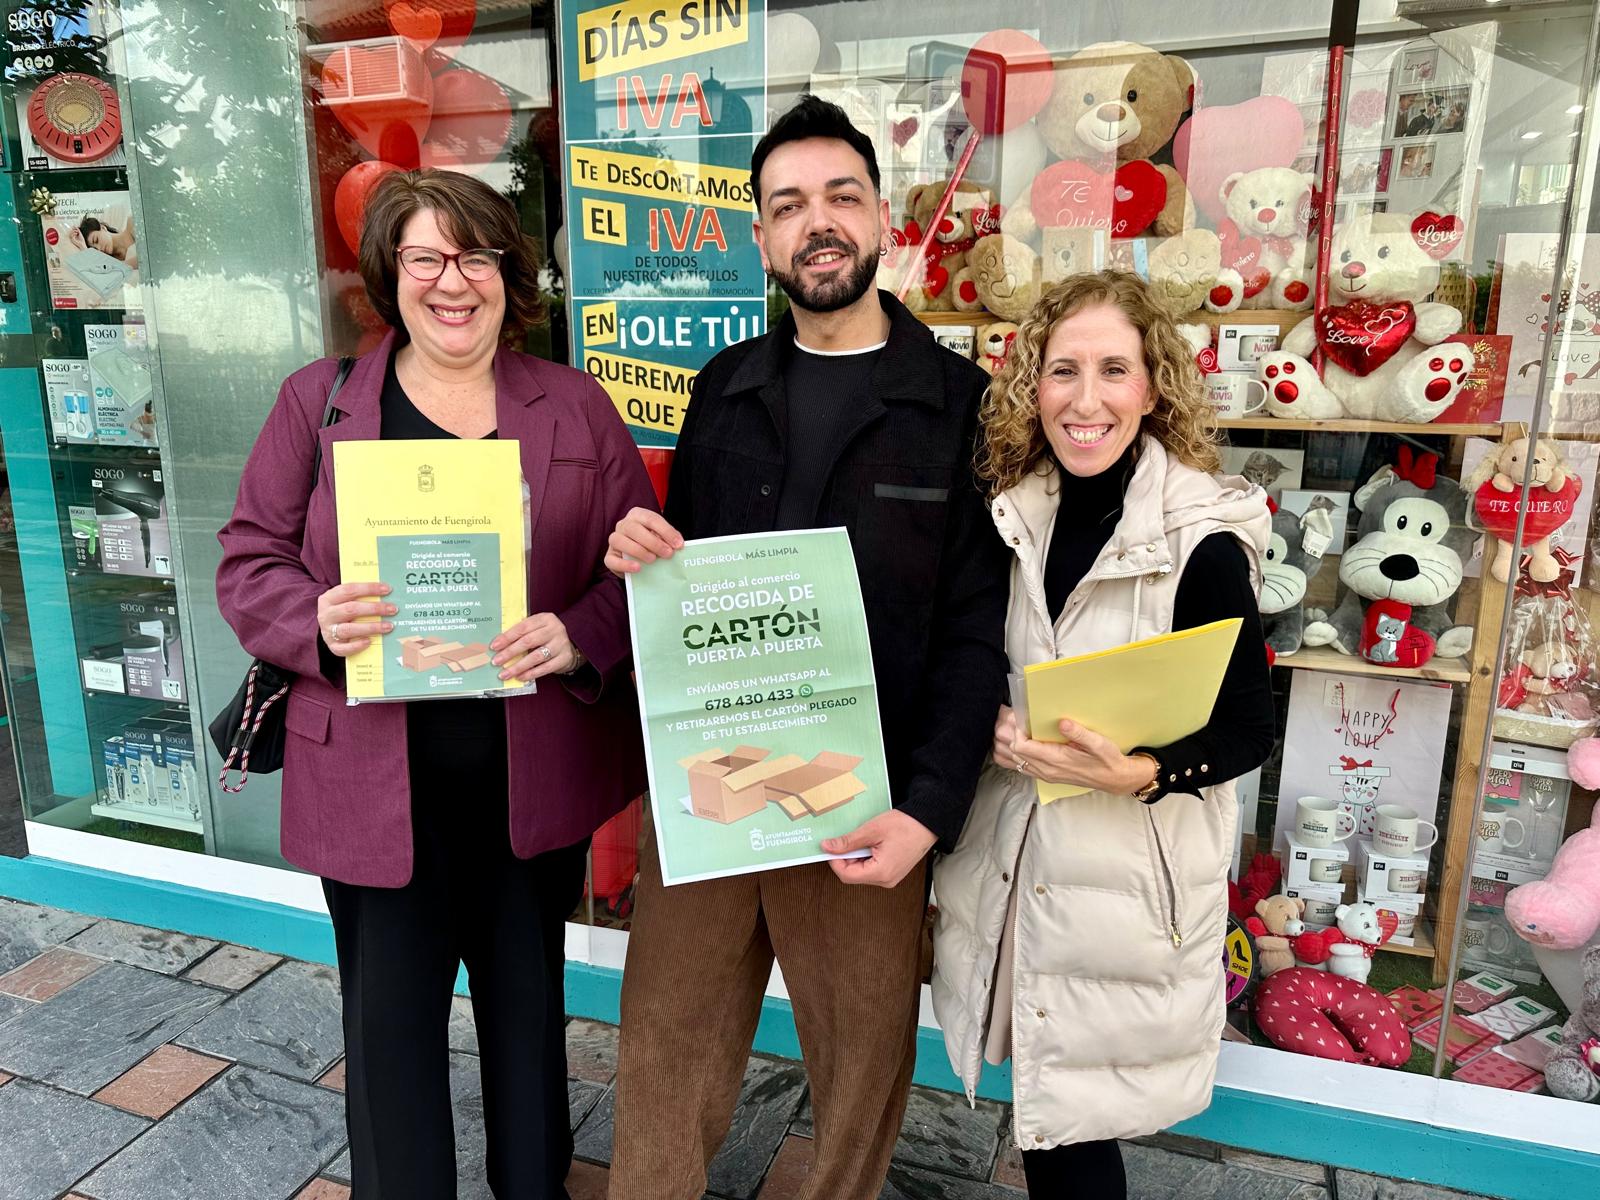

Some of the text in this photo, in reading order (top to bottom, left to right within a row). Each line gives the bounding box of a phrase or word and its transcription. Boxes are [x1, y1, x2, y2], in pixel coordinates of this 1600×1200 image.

[8, 9, 57, 32] SOGO
[584, 0, 742, 65] DÍAS SIN
[616, 72, 714, 130] IVA
[576, 158, 754, 203] TE DESCONTAMOS
[1060, 180, 1092, 203] TE
[1298, 200, 1320, 224] Love
[1056, 208, 1128, 233] Quiero
[591, 207, 728, 252] EL IVA
[1418, 224, 1461, 248] Love
[635, 255, 697, 268] DE TODOS
[603, 269, 666, 282] NUESTROS
[712, 286, 754, 295] PROMOCIÓN
[88, 328, 117, 339] SOGO
[586, 312, 615, 337] EN
[619, 315, 692, 349] ¡OLE
[1326, 329, 1369, 345] Love
[45, 363, 70, 373] SOGO
[627, 398, 675, 427] QUE
[94, 468, 125, 480] SOGO
[1489, 499, 1510, 513] TE
[365, 515, 491, 528] Ayuntamiento de Fuengirola
[411, 552, 436, 560] Dirigido
[684, 546, 799, 568] FUENGIROLA MÁS LIMPIA
[406, 558, 478, 570] RECOGIDA DE
[405, 567, 479, 586] CARTÓN
[690, 570, 801, 594] Dirigido al comercio
[406, 585, 438, 594] PUERTA
[447, 584, 479, 592] PUERTA
[120, 602, 145, 613] SOGO
[681, 583, 815, 617] RECOGIDA DE
[413, 610, 428, 618] 678
[682, 604, 821, 650] CARTÓN
[687, 635, 824, 666] PUERTA A PUERTA
[93, 666, 112, 674] SOGO
[686, 667, 832, 696] ENVÍANOS UN WHATSAPP AL
[704, 688, 794, 711] 678 430 433
[666, 696, 857, 732] Y RETIRAREMOS EL CARTÓN PLEGADO
[1341, 709, 1390, 729] HAPPY
[702, 714, 828, 741] DE TU ESTABLECIMIENTO
[124, 731, 146, 740] SOGO
[165, 736, 187, 745] SOGO
[1344, 731, 1380, 751] LOVE
[1487, 775, 1512, 787] MIGA
[1488, 769, 1508, 778] UPER
[1533, 783, 1552, 792] MIGA
[765, 827, 812, 840] AYUNTAMIENTO
[1480, 829, 1500, 837] MIGA
[766, 835, 813, 847] FUENGIROLA
[1471, 883, 1496, 894] MIGA
[1232, 962, 1249, 974] SHOE
